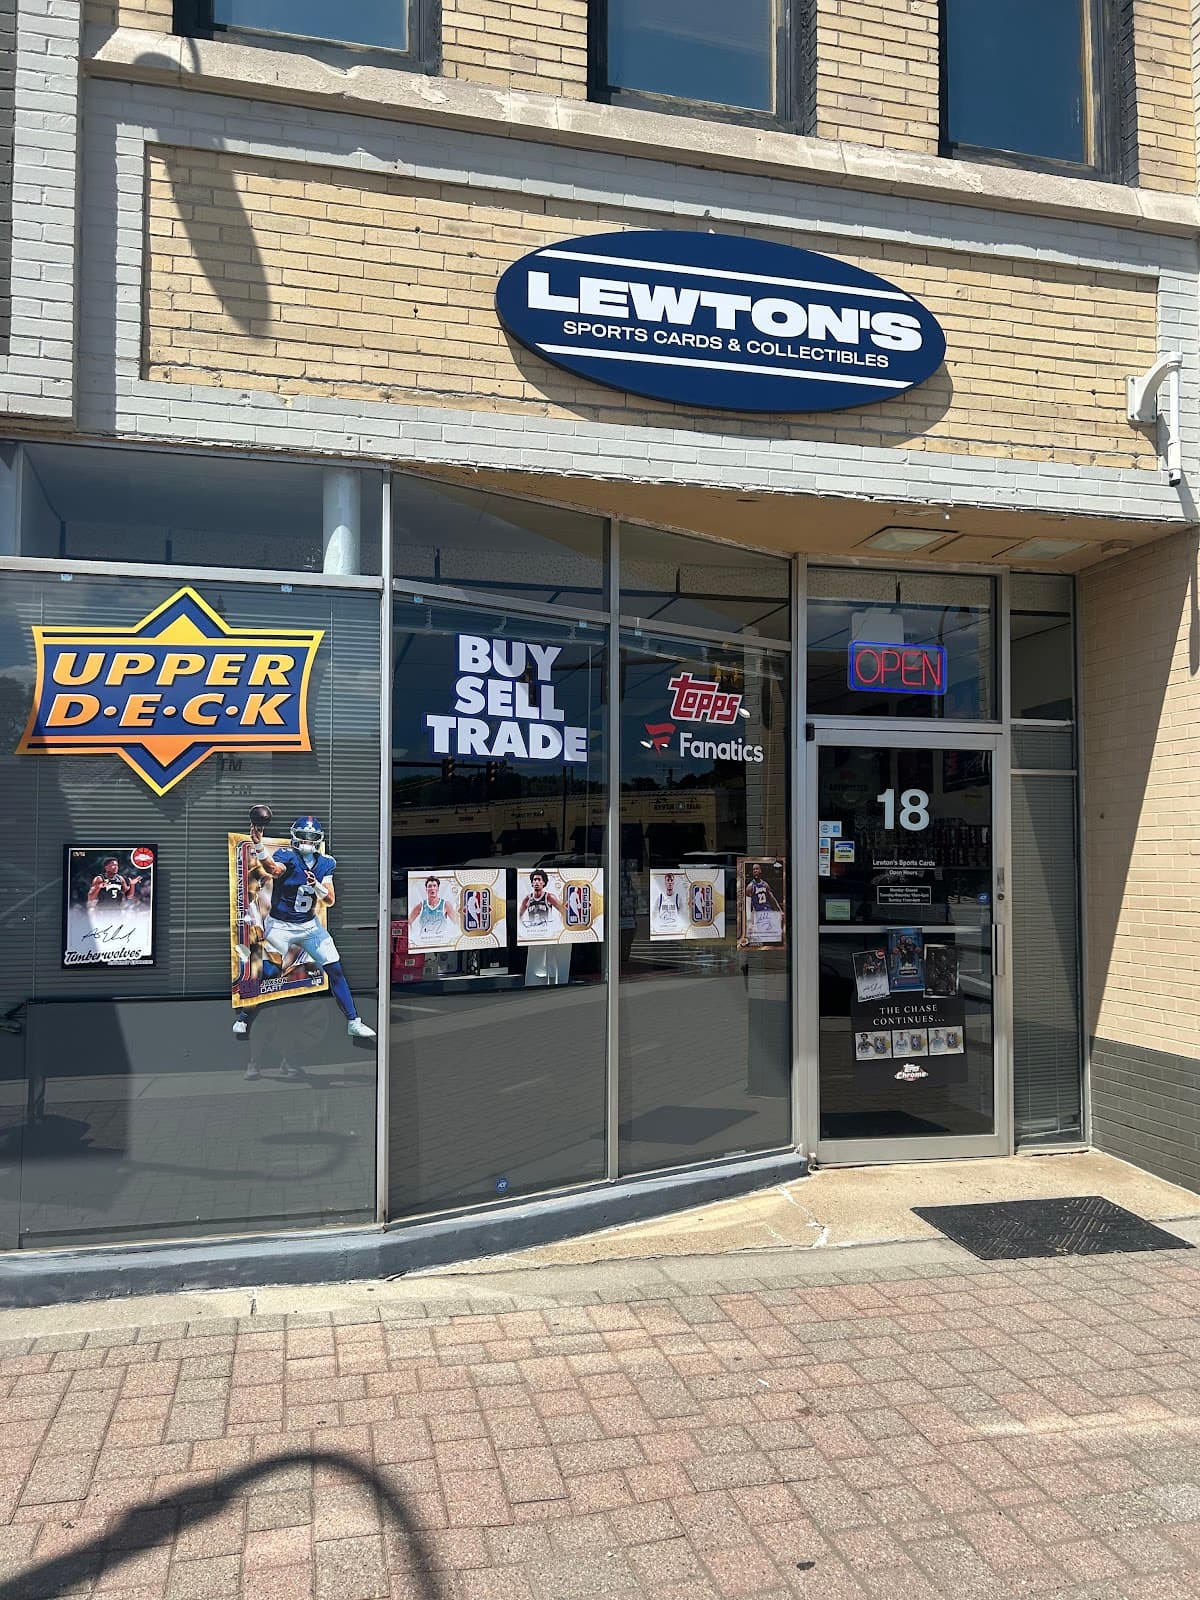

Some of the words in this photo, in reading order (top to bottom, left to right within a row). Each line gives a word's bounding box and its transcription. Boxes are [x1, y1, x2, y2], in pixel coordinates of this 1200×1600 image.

[527, 270, 922, 352] LEWTON'S
[563, 320, 649, 343] SPORTS
[653, 330, 723, 350] CARDS
[728, 338, 741, 352] &
[746, 340, 889, 369] COLLECTIBLES
[51, 652, 296, 687] UPPER
[458, 633, 562, 682] BUY
[855, 649, 941, 686] OPEN
[454, 675, 565, 722] SELL
[426, 714, 588, 763] TRADE
[679, 732, 764, 763] Fanatics
[876, 788, 930, 832] 18
[293, 884, 316, 913] 6
[64, 946, 142, 964] Timberwolves
[260, 985, 283, 994] DART
[873, 1014, 945, 1026] CONTINUES...
[879, 1006, 901, 1015] THE
[903, 1004, 938, 1014] CHASE
